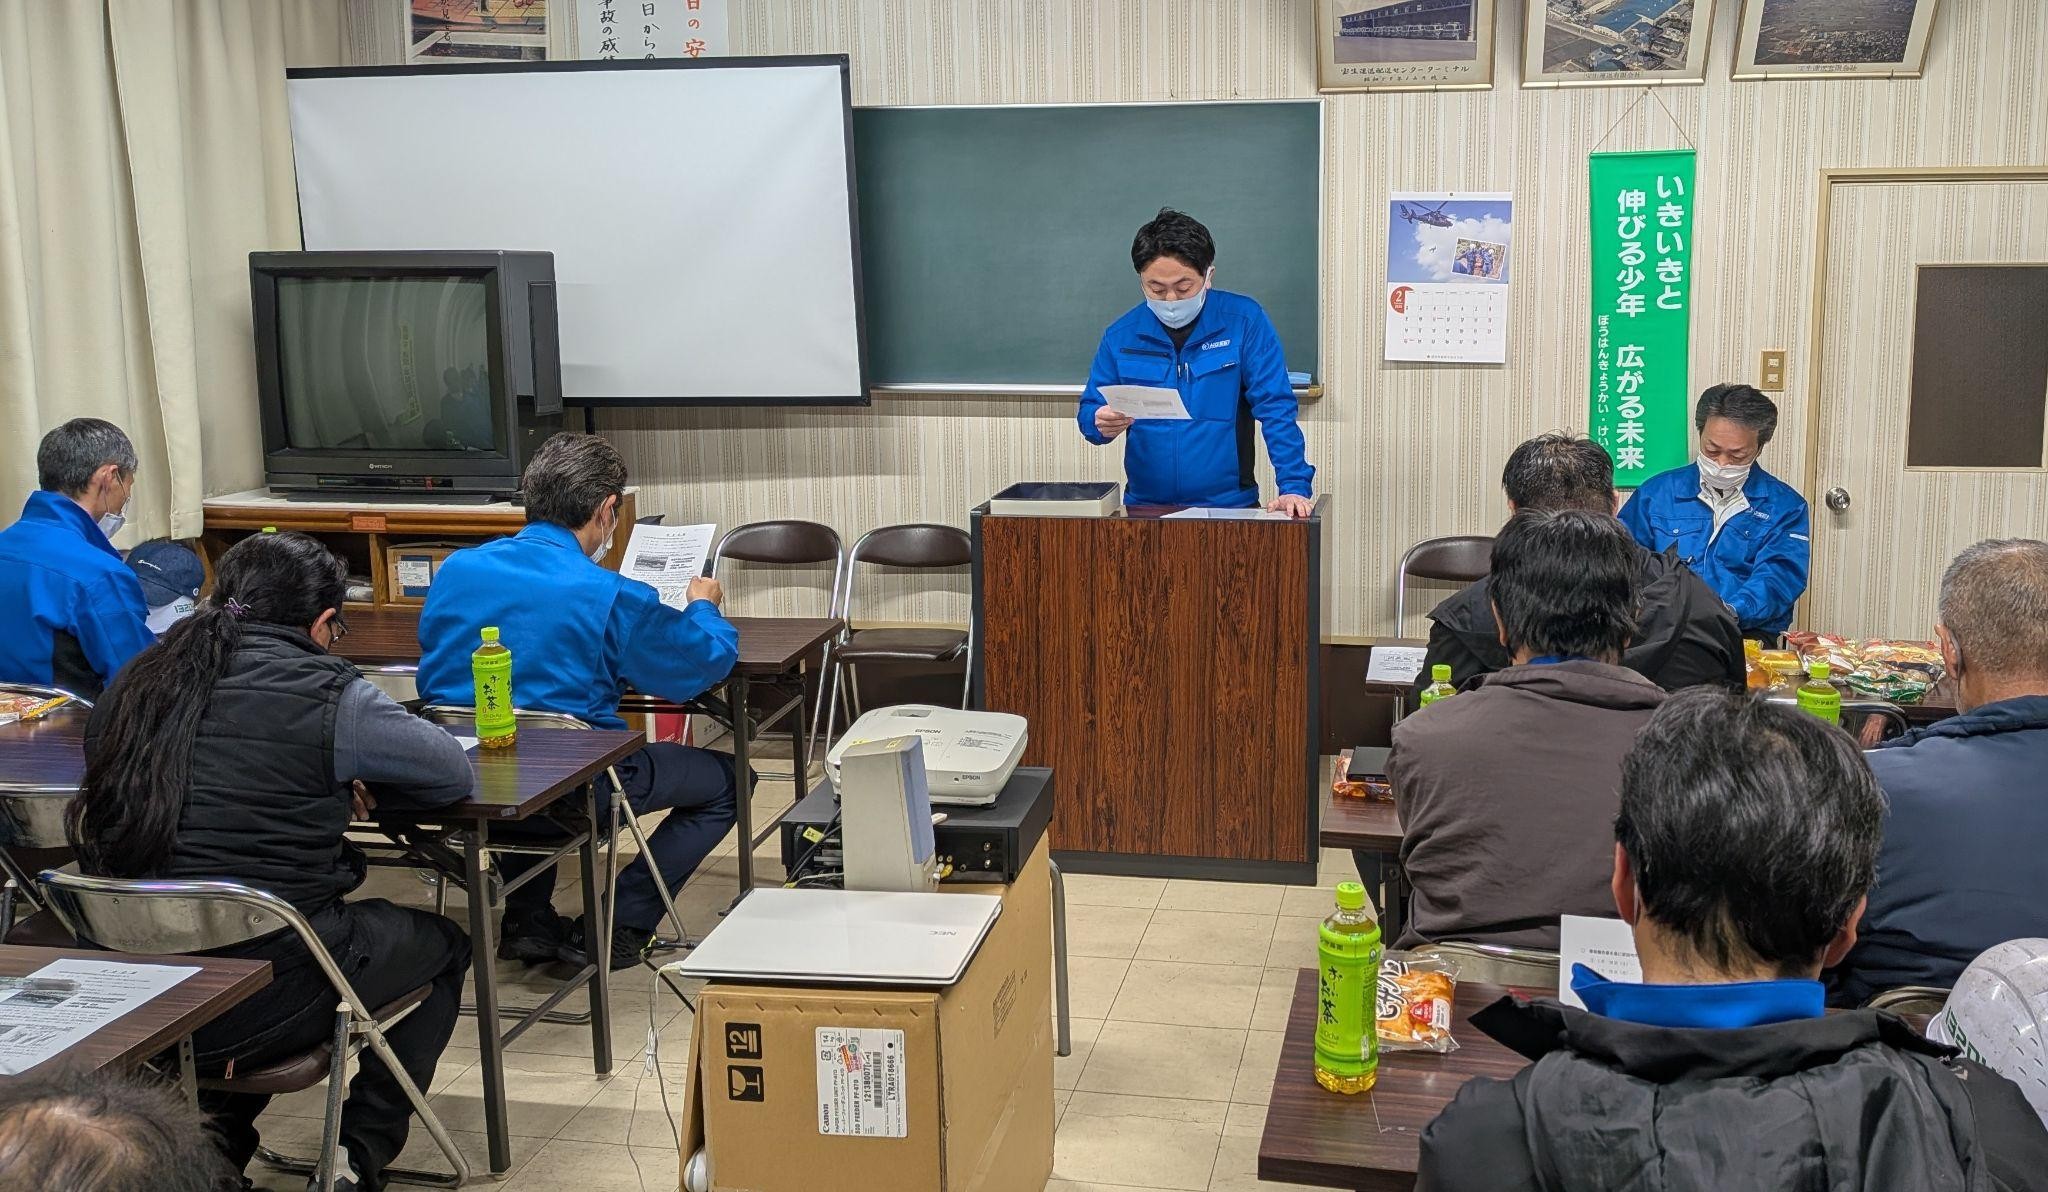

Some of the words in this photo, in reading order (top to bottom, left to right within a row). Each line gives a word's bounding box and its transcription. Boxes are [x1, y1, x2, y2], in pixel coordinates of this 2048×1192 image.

[1616, 189, 1647, 318] 伸びる少年
[1656, 175, 1685, 310] いきいきと
[1616, 344, 1646, 470] 広がる未来
[729, 1029, 744, 1053] 12
[823, 1035, 829, 1043] 14
